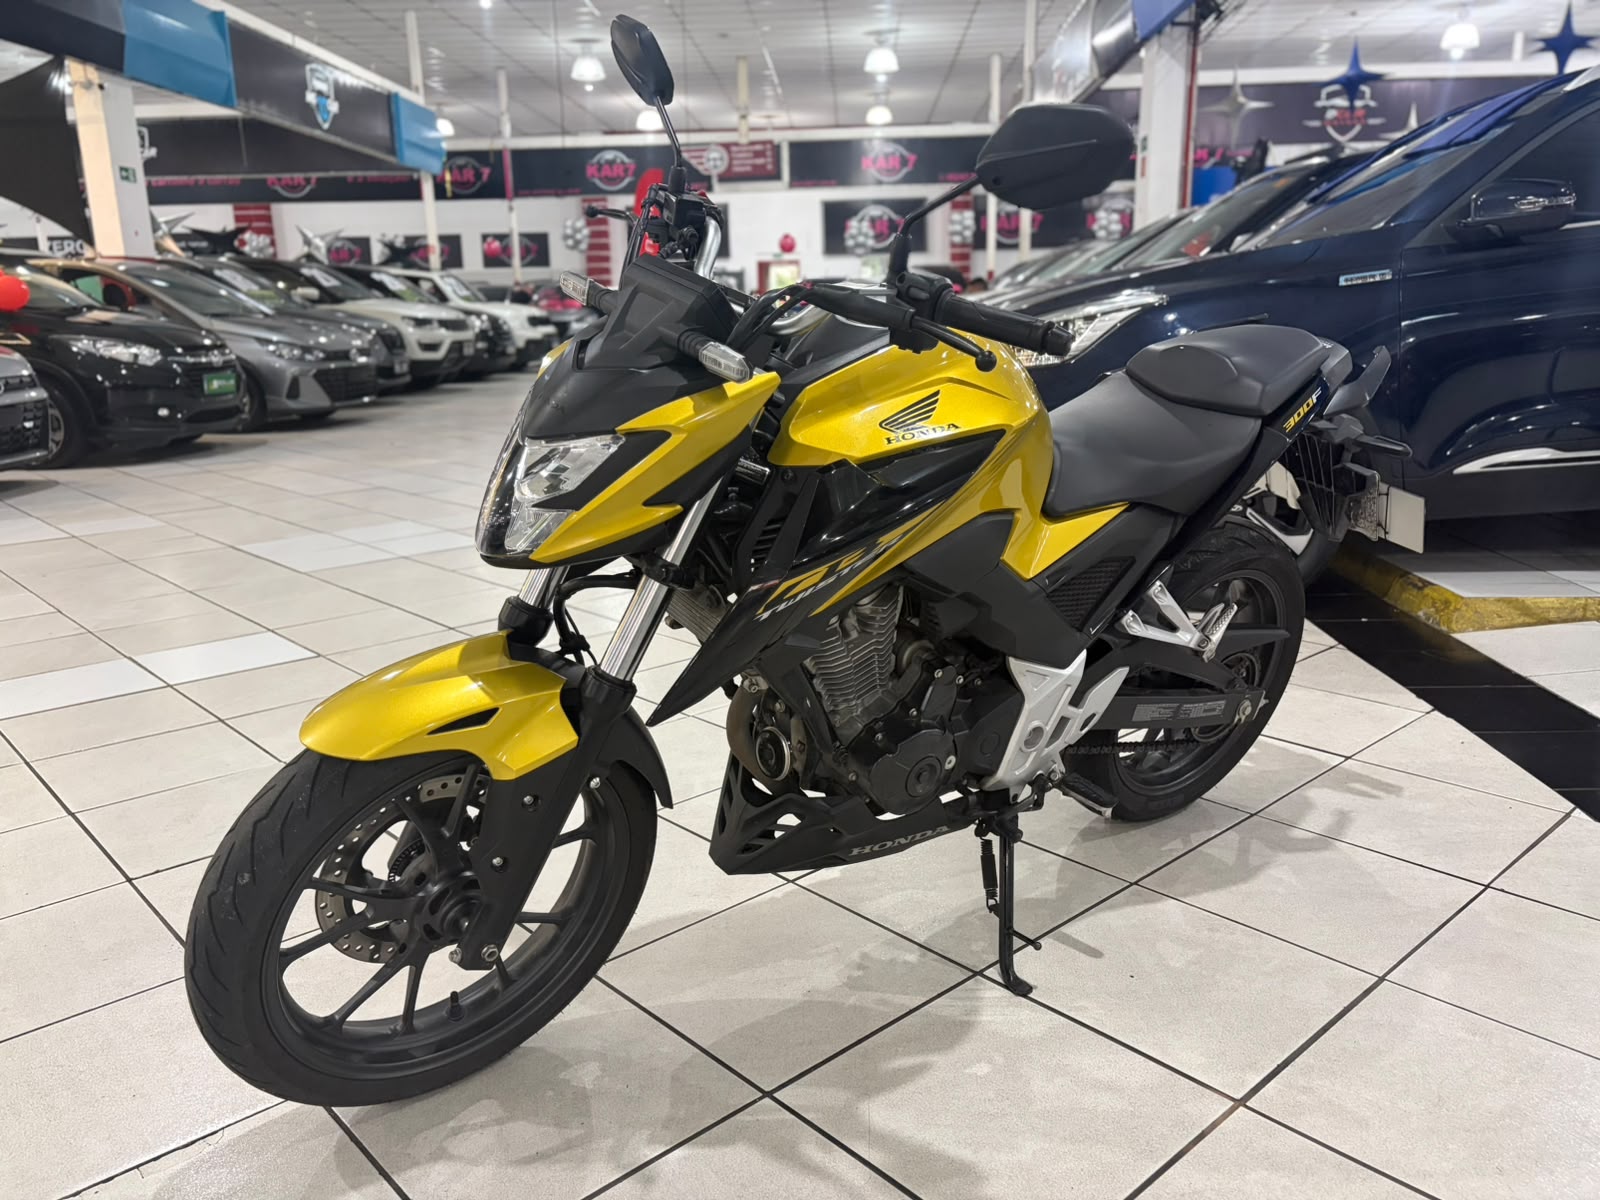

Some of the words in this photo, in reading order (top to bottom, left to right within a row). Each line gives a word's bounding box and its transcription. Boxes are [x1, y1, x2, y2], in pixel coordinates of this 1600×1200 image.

[1283, 386, 1322, 433] 300F
[885, 423, 961, 445] HONDA
[847, 825, 949, 857] HONDA
